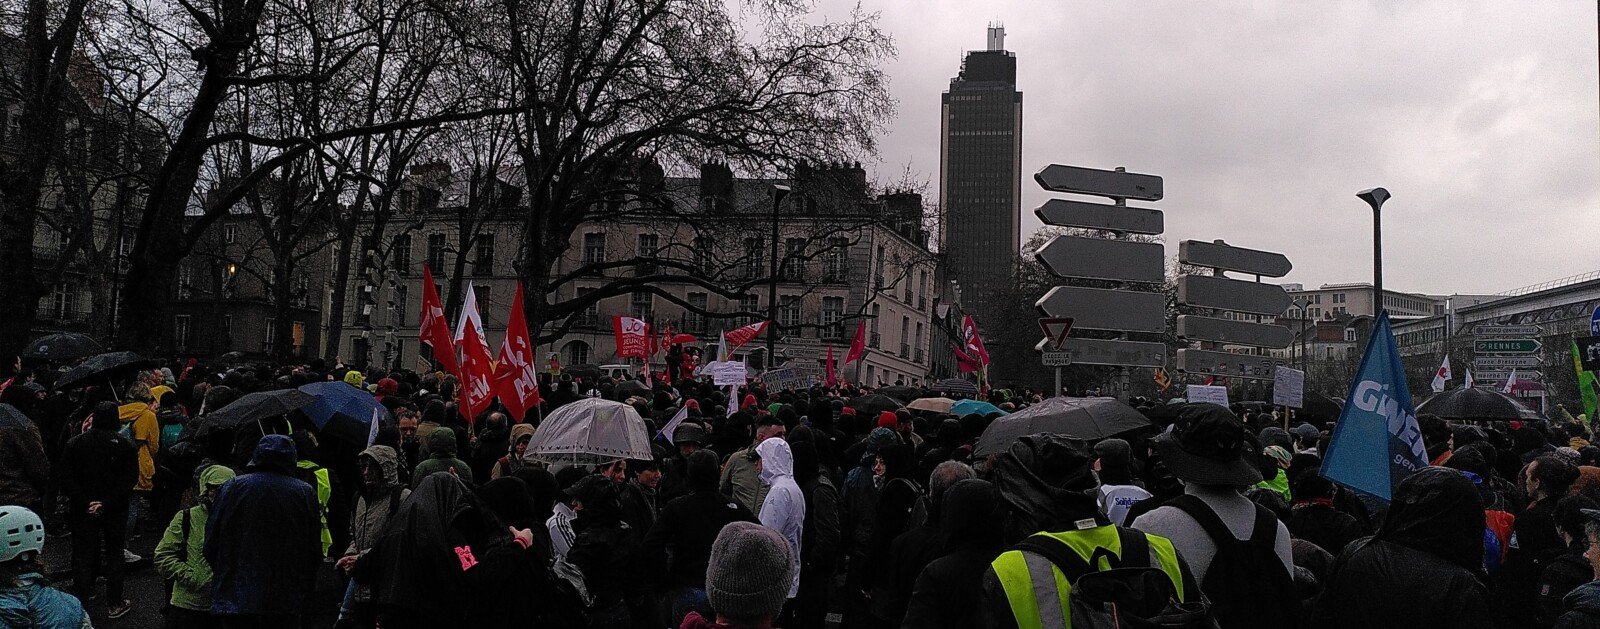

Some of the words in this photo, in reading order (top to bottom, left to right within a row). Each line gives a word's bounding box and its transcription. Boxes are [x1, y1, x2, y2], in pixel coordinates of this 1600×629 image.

[622, 337, 646, 346] JEUNES
[1488, 342, 1521, 350] RENNES
[1497, 358, 1527, 366] Bretagne
